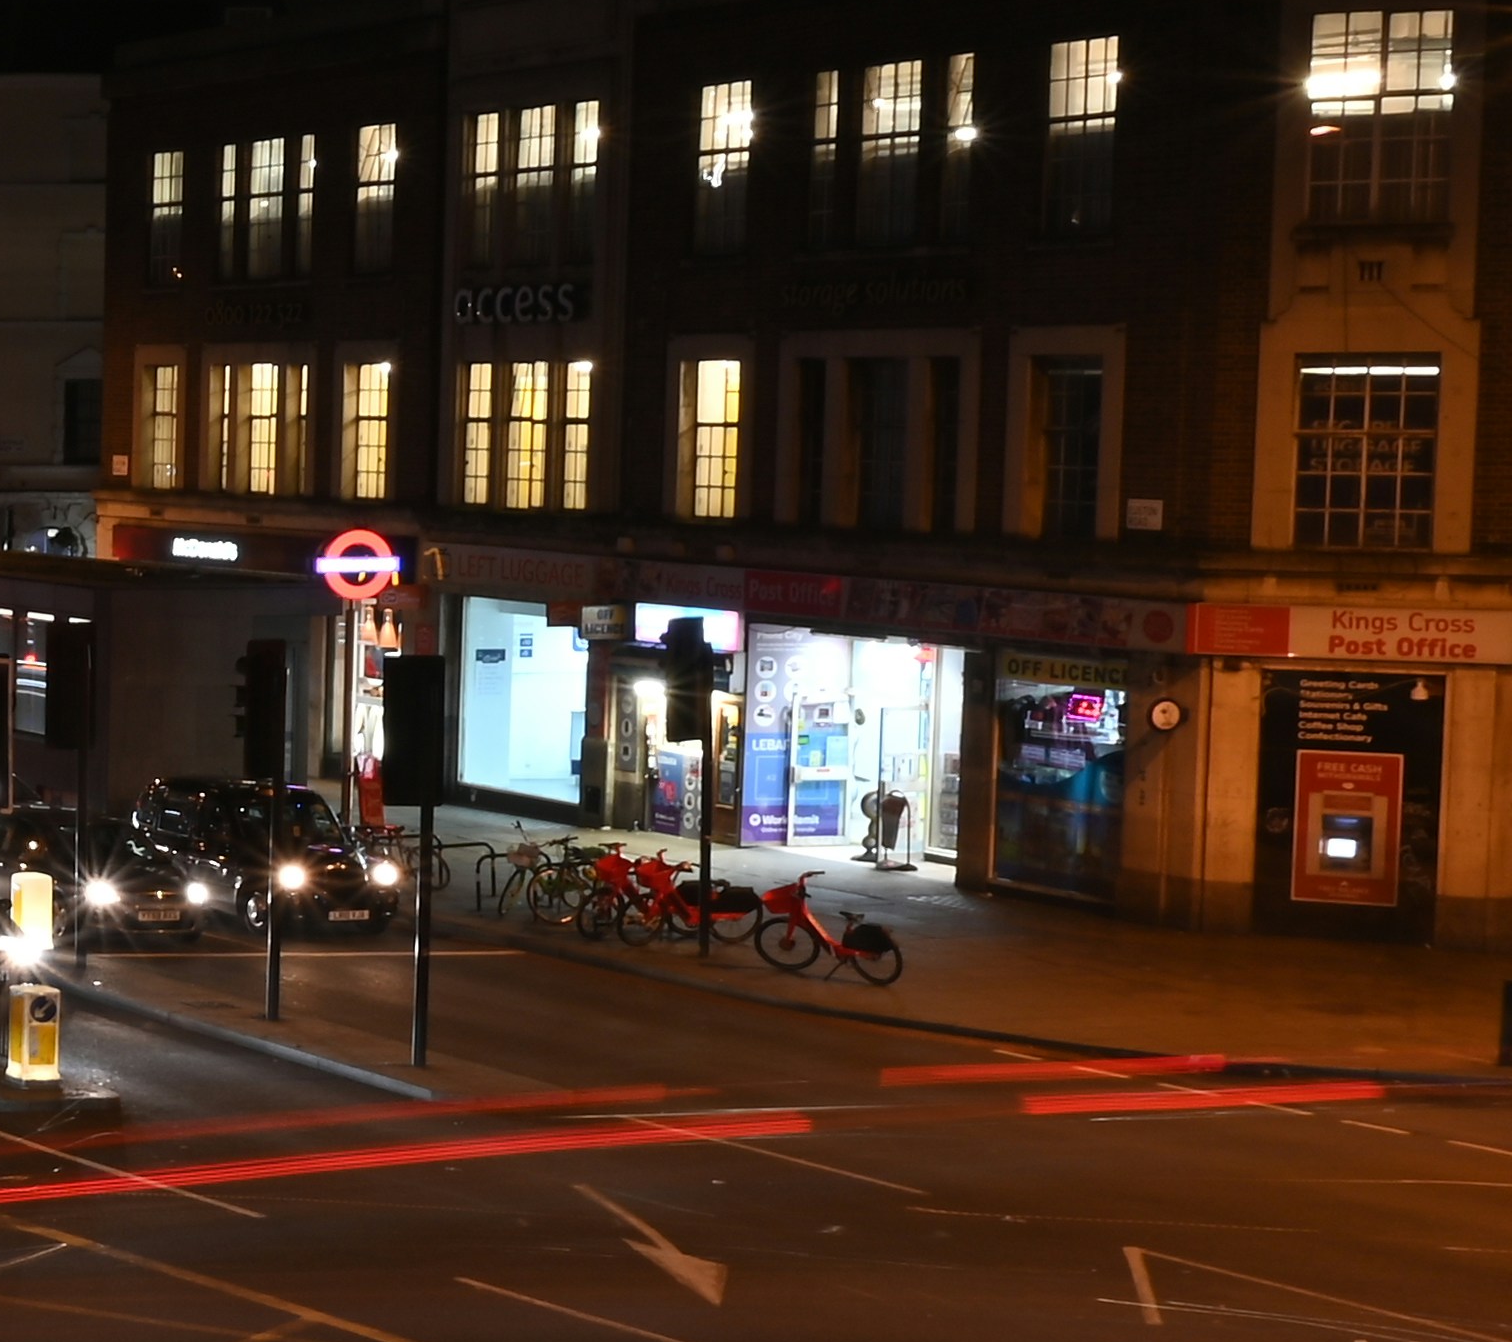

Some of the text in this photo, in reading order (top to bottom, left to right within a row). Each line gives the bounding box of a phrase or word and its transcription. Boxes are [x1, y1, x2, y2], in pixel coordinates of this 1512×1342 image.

[781, 270, 966, 315] storage solutions
[454, 283, 574, 323] access
[205, 300, 244, 326] 0800
[248, 302, 272, 324] 122
[457, 555, 585, 588] LEFT LUGGAGE
[666, 573, 743, 600] Kings Cross
[749, 578, 836, 606] Post Office
[596, 610, 614, 621] OFF
[1332, 610, 1476, 635] Kings Cross
[584, 622, 625, 636] LICENCE
[1328, 635, 1477, 659] Post Office
[1007, 659, 1043, 675] OFF
[1299, 678, 1380, 690] Greeting Cards
[1298, 700, 1351, 710] Souvenirs
[1362, 702, 1389, 712] Gifts
[1298, 711, 1341, 720] Internet
[1297, 721, 1365, 732] Coffee Shop
[752, 738, 801, 752] LEBA
[1316, 761, 1383, 774] FREE CASH
